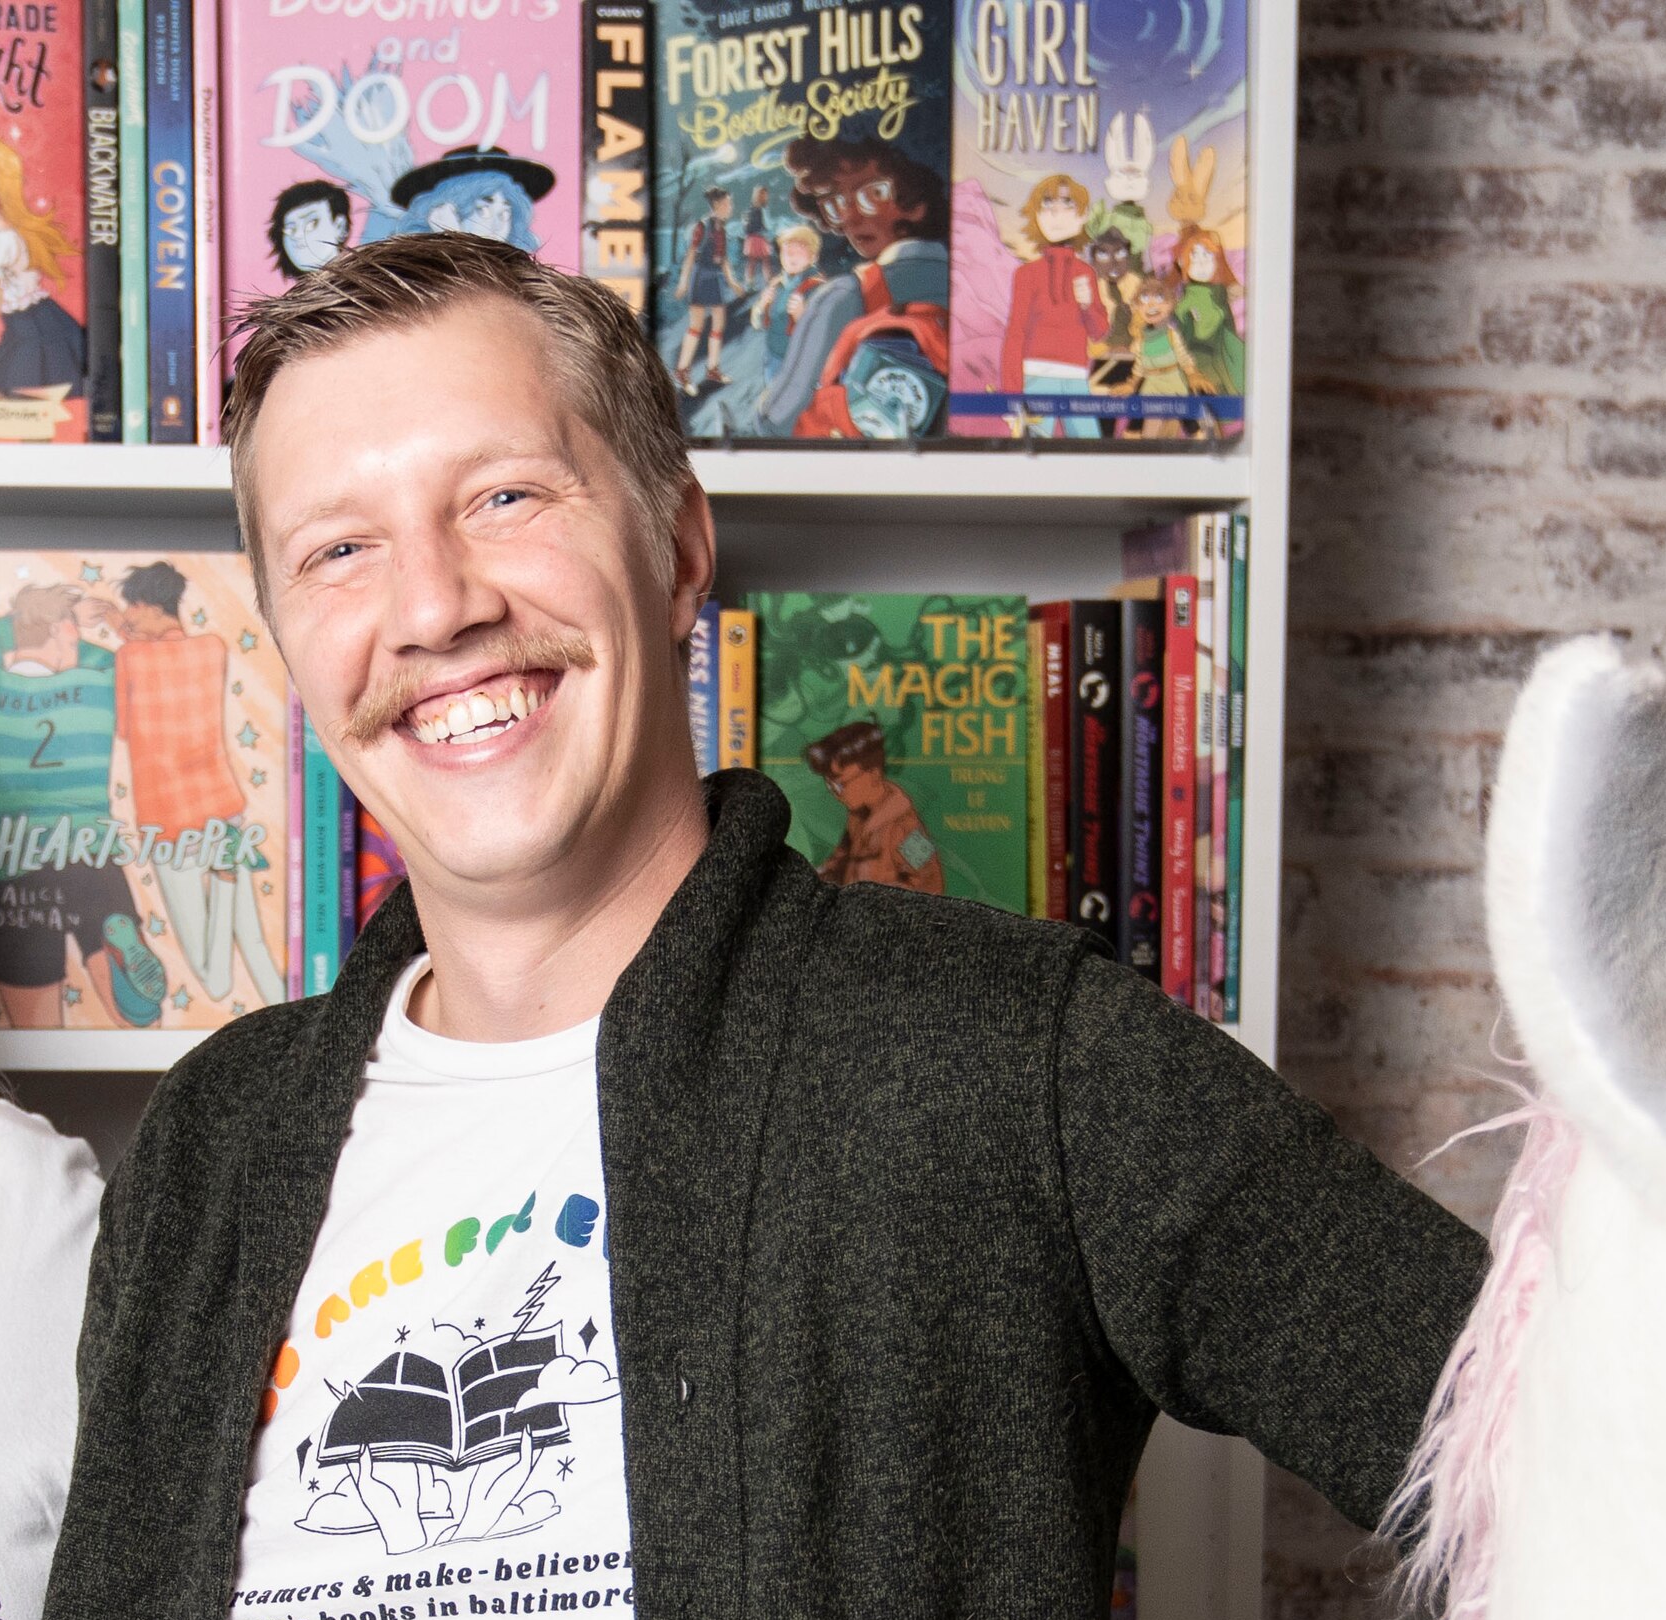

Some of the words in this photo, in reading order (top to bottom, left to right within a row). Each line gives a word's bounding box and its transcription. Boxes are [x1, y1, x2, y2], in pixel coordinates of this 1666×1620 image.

[596, 4, 645, 20] CURATO
[718, 9, 750, 29] DAVE
[753, 2, 792, 22] BAKER
[156, 38, 167, 85] SEATON
[377, 26, 462, 65] and
[665, 24, 811, 105] FOREST
[819, 4, 924, 76] HILLS
[976, 0, 1097, 87] GIRL
[170, 59, 181, 101] DUGAN
[255, 63, 551, 154] DOOM
[678, 88, 809, 169] Bootleg
[806, 67, 919, 141] Society
[976, 91, 1100, 153] HAVEN
[88, 106, 119, 246] BLACKWATER
[153, 159, 188, 291] COVEN
[688, 617, 712, 686] KISS
[920, 614, 1016, 660] THE
[847, 662, 1019, 708] MAGIC
[1046, 642, 1064, 698] MEAL
[28, 719, 64, 769] 2
[729, 708, 747, 751] Life
[922, 711, 1016, 756] FISH
[1171, 673, 1192, 772] Mooncakes
[1, 885, 67, 906] ALICE
[315, 1237, 424, 1339] ARE
[229, 1580, 344, 1609] reamers
[352, 1575, 375, 1598] &
[384, 1549, 633, 1595] make-believer
[427, 1597, 459, 1618] in
[469, 1586, 634, 1617] baltimore
